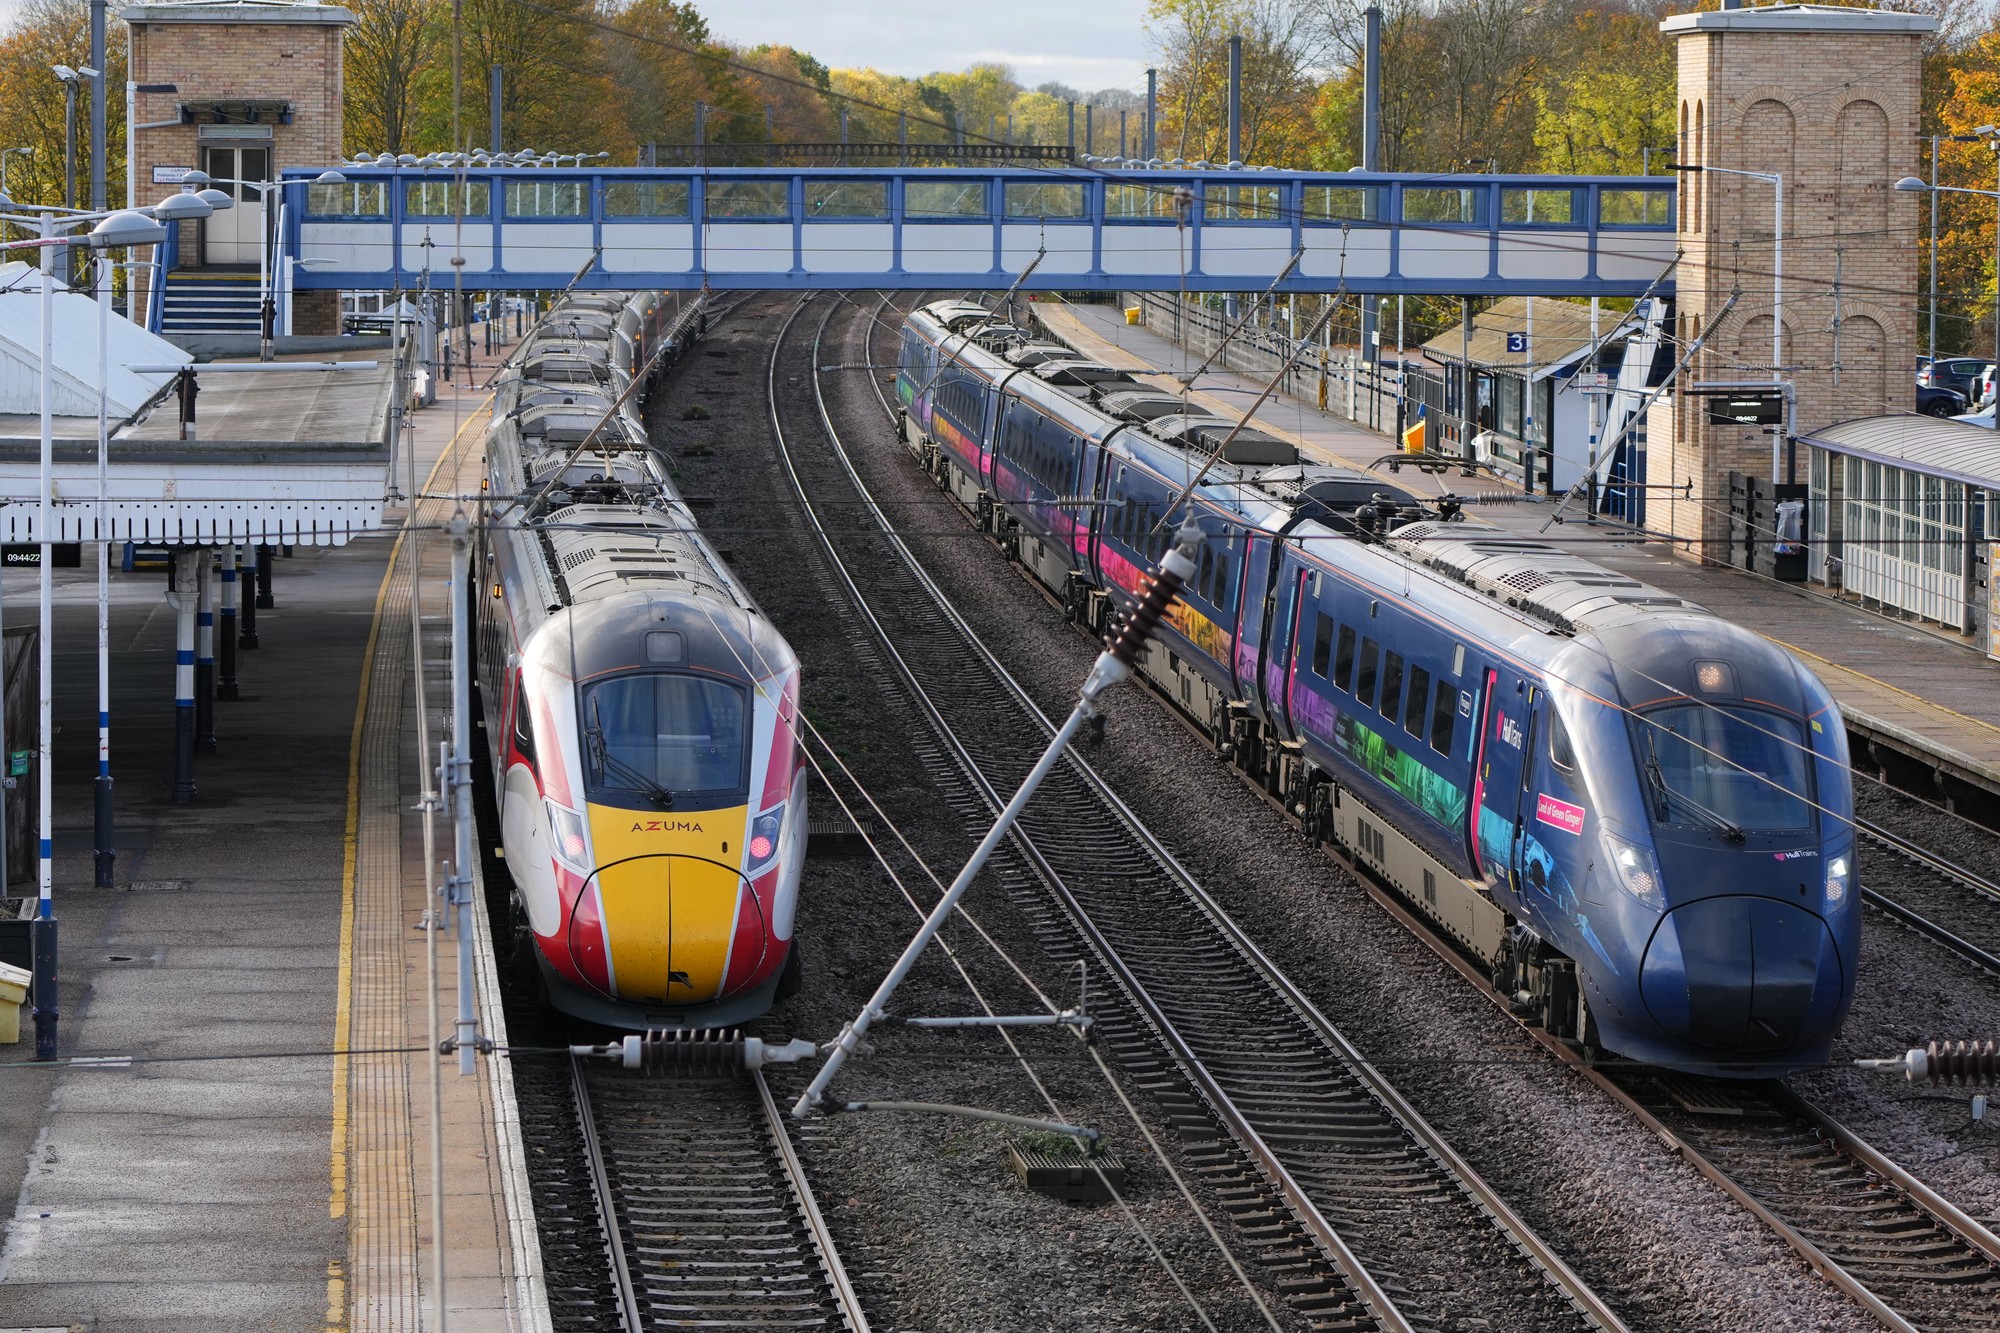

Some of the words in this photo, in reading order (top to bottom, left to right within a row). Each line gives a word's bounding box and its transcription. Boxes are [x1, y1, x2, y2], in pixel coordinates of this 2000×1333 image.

[1511, 334, 1523, 350] 3
[1538, 800, 1548, 815] Land
[1552, 805, 1565, 820] Green
[1565, 809, 1581, 827] Ginger
[631, 821, 704, 832] AZUMA
